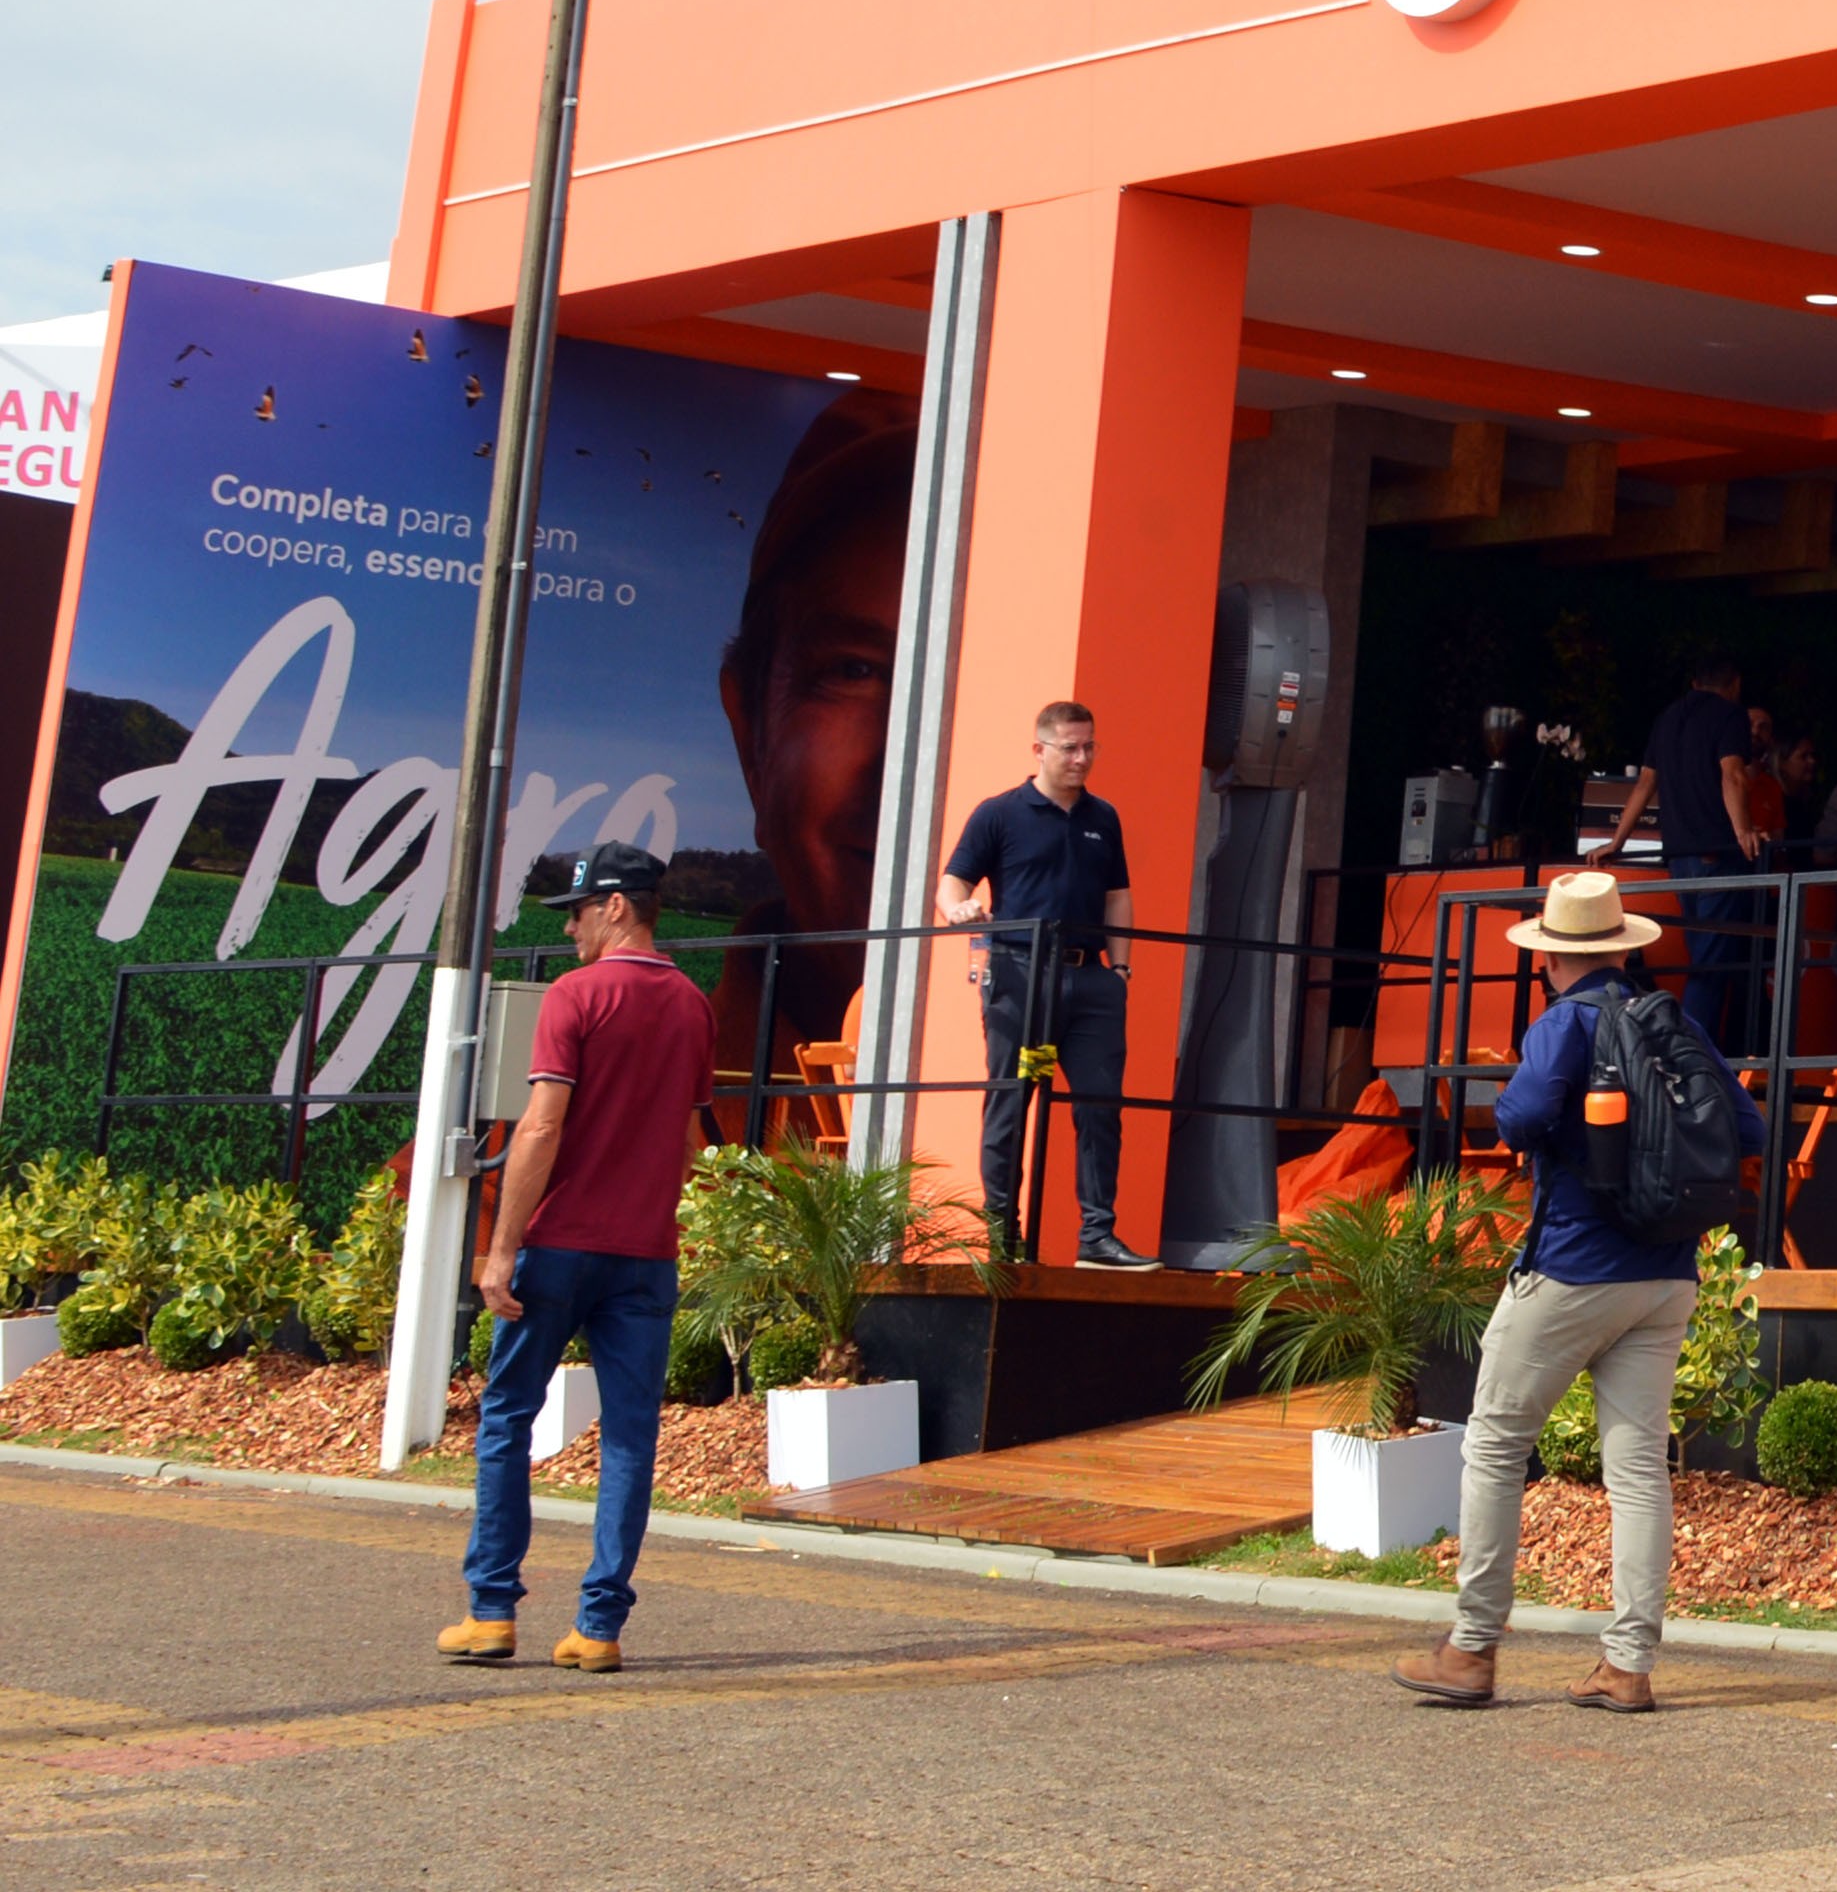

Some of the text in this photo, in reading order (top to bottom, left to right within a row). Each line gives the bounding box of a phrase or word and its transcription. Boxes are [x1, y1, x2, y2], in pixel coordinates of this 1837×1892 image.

[211, 474, 577, 553] Completa para em
[204, 527, 636, 606] coopera, essenc para o
[98, 596, 677, 1120] Agro
